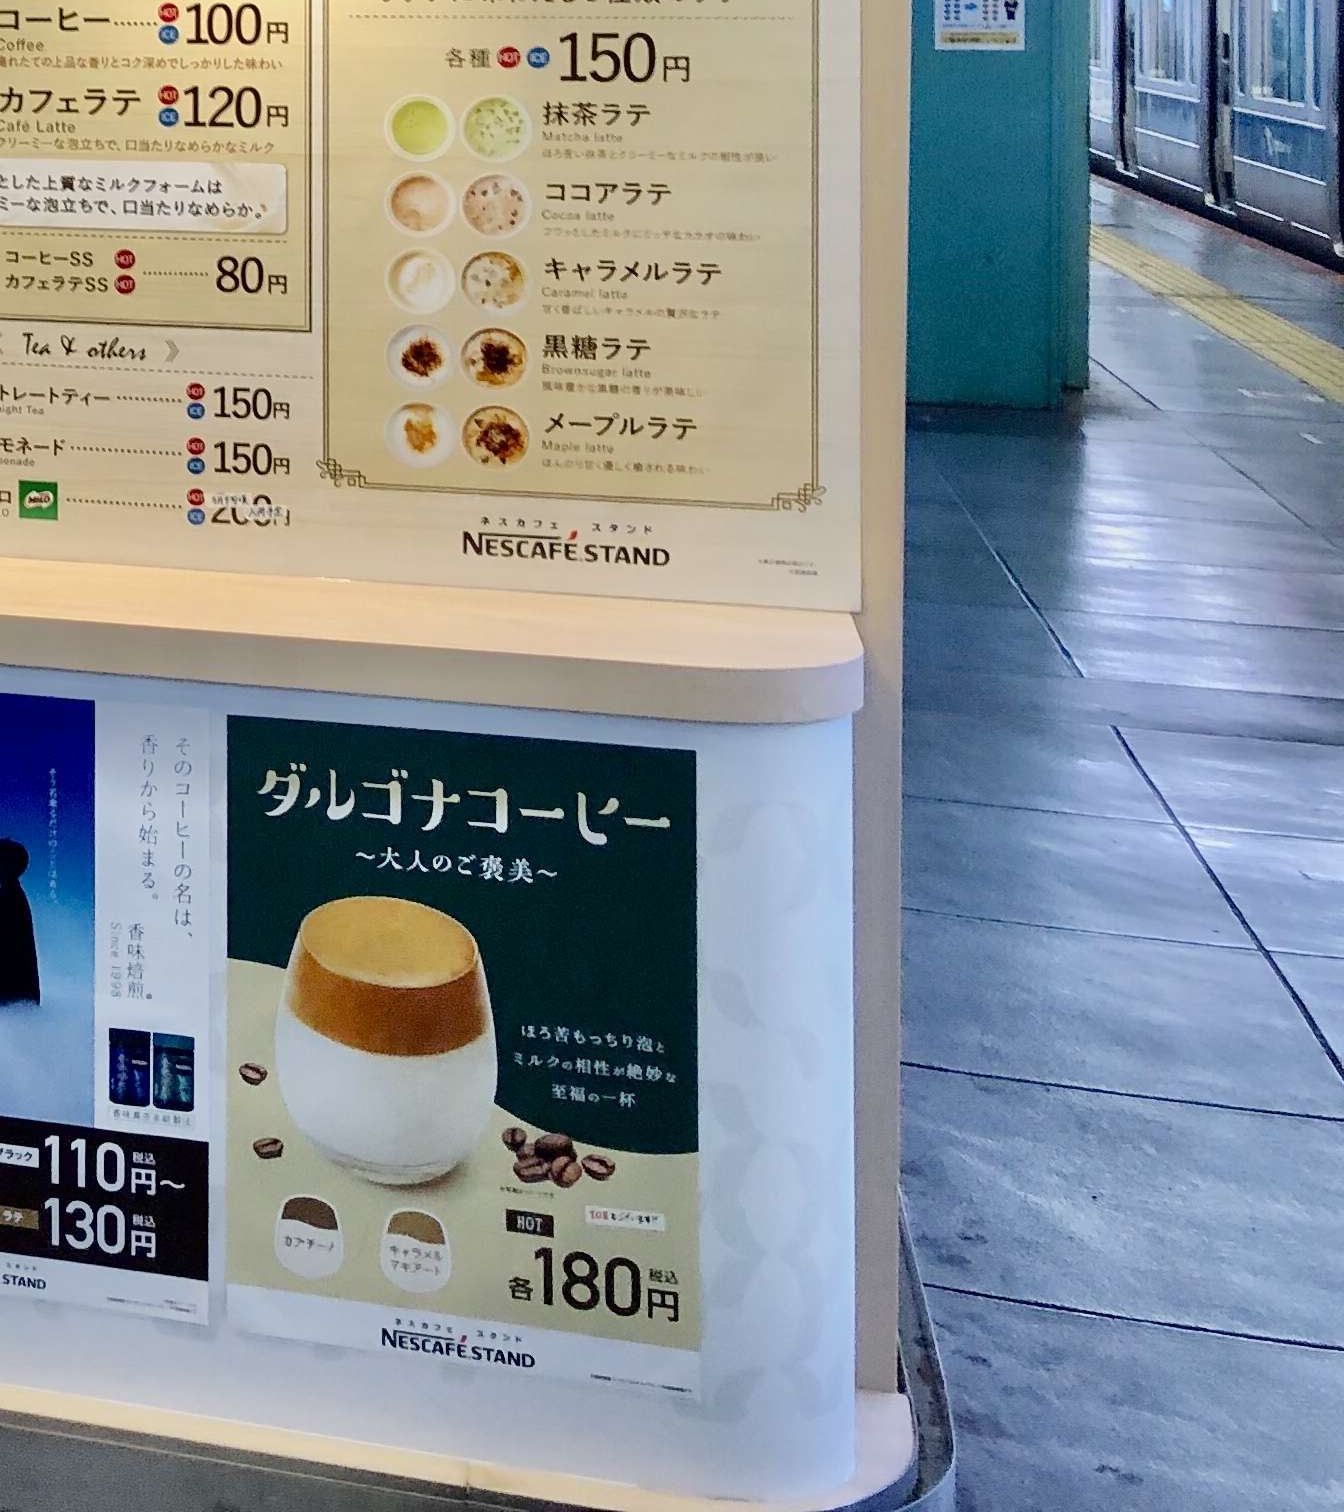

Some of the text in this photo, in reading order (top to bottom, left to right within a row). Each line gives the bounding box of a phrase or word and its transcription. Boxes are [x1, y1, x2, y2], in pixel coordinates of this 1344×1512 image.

[186, 2, 289, 45] 100円
[444, 48, 490, 69] 各種
[558, 31, 691, 85] 150円
[0, 86, 142, 116] カフェラテ
[184, 85, 289, 128] 120円
[36, 119, 76, 134] Latte
[542, 100, 652, 128] 抹茶ラテ
[542, 131, 624, 145] Matcha latte
[545, 181, 672, 206] ココアラテ
[541, 209, 615, 223] Cocoa latte
[4, 249, 94, 268] コーヒーSS
[4, 275, 109, 293] カフェラテSS
[215, 255, 289, 295] 80円
[544, 257, 723, 287] キャラメルラテ
[598, 288, 628, 300] latte
[22, 332, 50, 357] Tea
[88, 338, 147, 362] others
[542, 334, 652, 361] 黒糖ラテ
[621, 367, 652, 379] latte
[26, 404, 45, 417] Tea
[212, 386, 290, 421] 150円
[544, 412, 698, 440] メープルラテ
[212, 441, 290, 476] 150円
[541, 440, 614, 454] Maple latte
[480, 516, 653, 534] ネスカフェ スタンド
[584, 544, 671, 567] STAND
[255, 761, 672, 846] ダルゴナコーヒー
[138, 733, 160, 901] 香りから始まる。
[173, 737, 194, 938] そのコーヒーの名は、
[521, 1024, 665, 1054] ほろ苦もっちり泡と
[512, 1051, 678, 1084] ミルクの相性が絶妙な
[551, 1083, 637, 1109] 至福の一杯
[132, 1150, 157, 1166] 税込
[2, 1209, 24, 1225] ラテ
[43, 1197, 157, 1259] 130円
[132, 1213, 157, 1228] 税込
[516, 1214, 544, 1233] HOT
[2, 1273, 47, 1291] STAND
[648, 1267, 679, 1285] 税込
[472, 1344, 537, 1369] STAND
